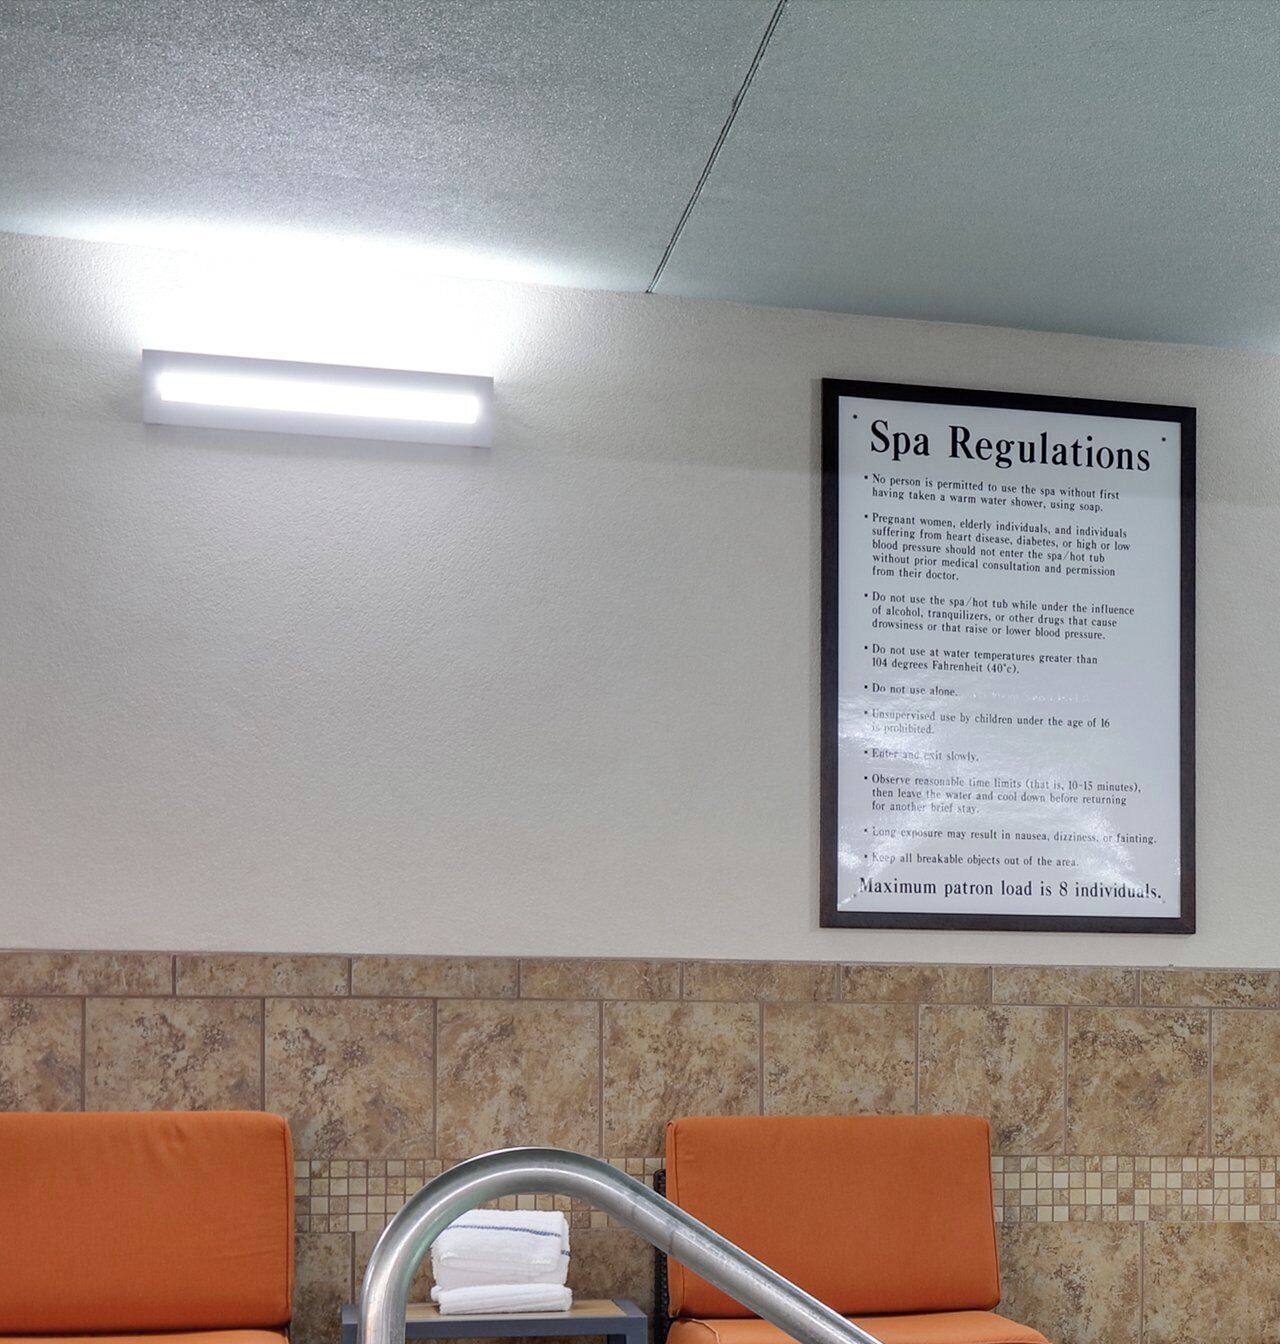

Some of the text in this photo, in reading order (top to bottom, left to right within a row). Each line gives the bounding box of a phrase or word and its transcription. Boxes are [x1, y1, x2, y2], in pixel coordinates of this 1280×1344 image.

[870, 419, 1152, 472] Spa Regulations
[872, 473, 1120, 500] No person is permitted to use the spa without first
[872, 486, 1104, 514] having taken a warm water shower, using soap.
[872, 512, 1128, 539] Pregnant women, elderly individuals, and individuals
[872, 525, 1130, 551] suffering from heart disease, diabetes, or high or low
[872, 538, 1106, 564] blood pressure should not enter the spa/hot tub
[872, 552, 1116, 577] without prior medical consultation and permission
[872, 565, 959, 581] from their doctor.
[872, 590, 1135, 616] Do not use the spa/hot tub while under the influence
[871, 604, 1118, 628] of alcohol, tranquilizers, or other drugs that cause
[871, 618, 924, 631] drowsiness
[941, 622, 961, 633] that
[965, 623, 988, 634] raise
[991, 627, 1002, 635] or
[1006, 625, 1032, 637] lower
[1035, 626, 1061, 638] blood
[1064, 630, 1106, 640] pressure.
[872, 643, 1098, 665] Do not use at water temperatures greater than
[872, 656, 888, 668] 104
[891, 657, 929, 671] degrees
[932, 659, 983, 673] Fahrenheit
[872, 682, 959, 697] Do not use alone.
[940, 714, 957, 723] use
[959, 712, 972, 725] by
[974, 713, 1013, 725] children
[1016, 715, 1044, 726] under
[1047, 716, 1064, 727] the
[1066, 719, 1084, 729] age
[1086, 717, 1097, 728] of
[1101, 718, 1111, 729] 16
[871, 773, 1142, 793] Observe time limits 10-15 minutes),
[871, 799, 886, 812] for
[872, 787, 1127, 807] then leave water and cool down before returning
[900, 829, 1157, 846] exposure may result in nausea, fainting.
[899, 852, 913, 863] all
[916, 853, 964, 865] breakable
[966, 854, 1001, 867] objects
[1003, 857, 1020, 866] out
[1023, 855, 1033, 866] of
[1037, 856, 1053, 867] the
[859, 877, 1162, 899] Maximum patron load is 8 individuals.
